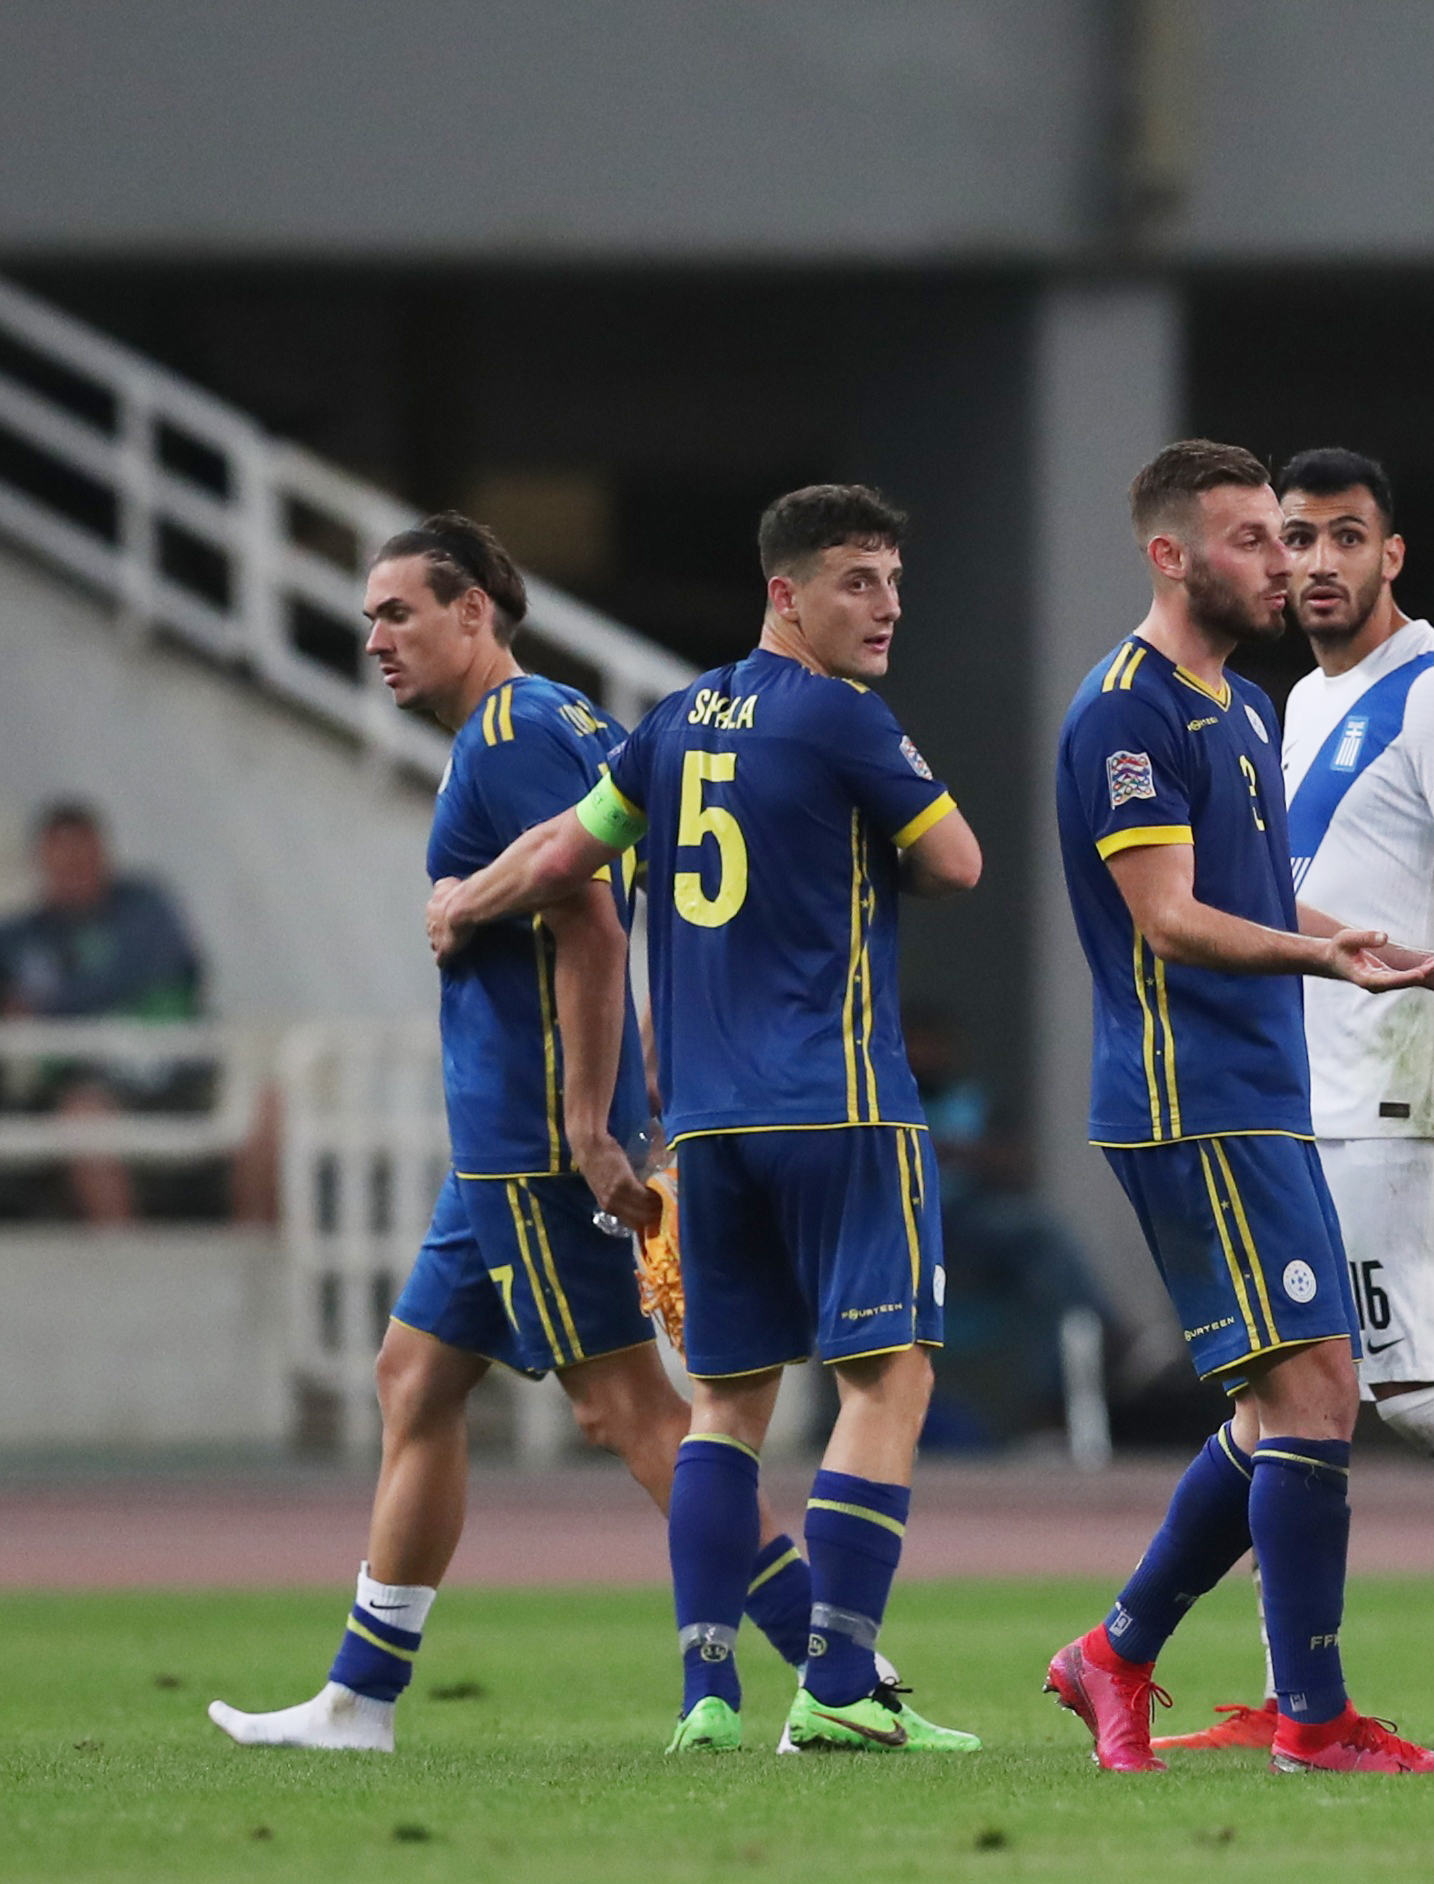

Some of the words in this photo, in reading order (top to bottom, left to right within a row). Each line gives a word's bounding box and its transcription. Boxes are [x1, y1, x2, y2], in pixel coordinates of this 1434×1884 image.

[674, 750, 748, 928] 5
[841, 1303, 903, 1320] FOURTEEN
[1349, 1260, 1390, 1331] 16
